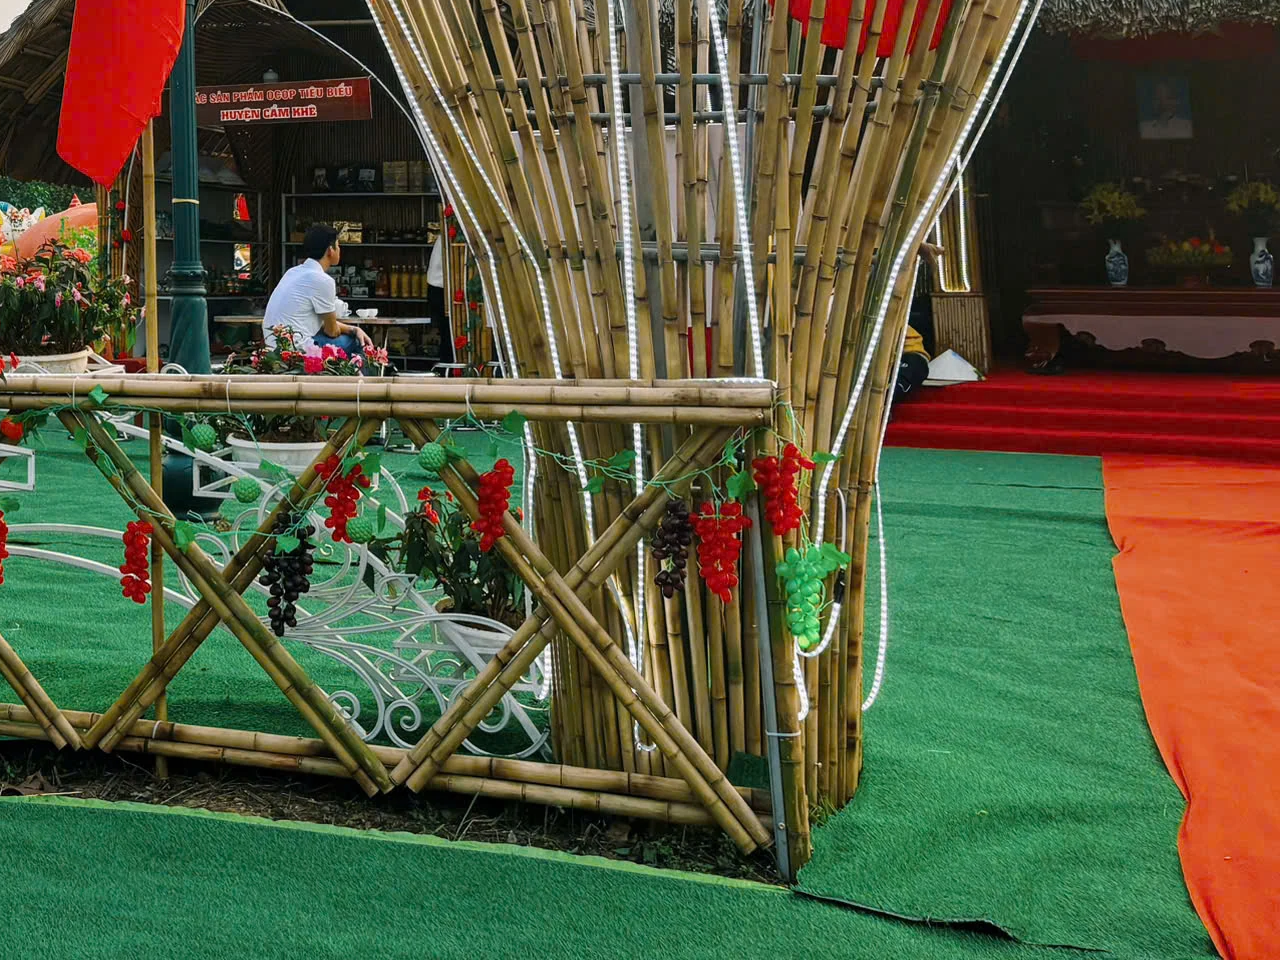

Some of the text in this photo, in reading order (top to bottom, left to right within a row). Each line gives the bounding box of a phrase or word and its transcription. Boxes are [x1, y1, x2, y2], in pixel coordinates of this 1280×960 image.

[209, 90, 230, 103] SẢN
[232, 87, 264, 102] PHẨM
[266, 89, 296, 101] OCOP
[298, 86, 324, 99] TIÊU
[220, 107, 261, 122] HUYỆN
[292, 104, 318, 118] KHÊ
